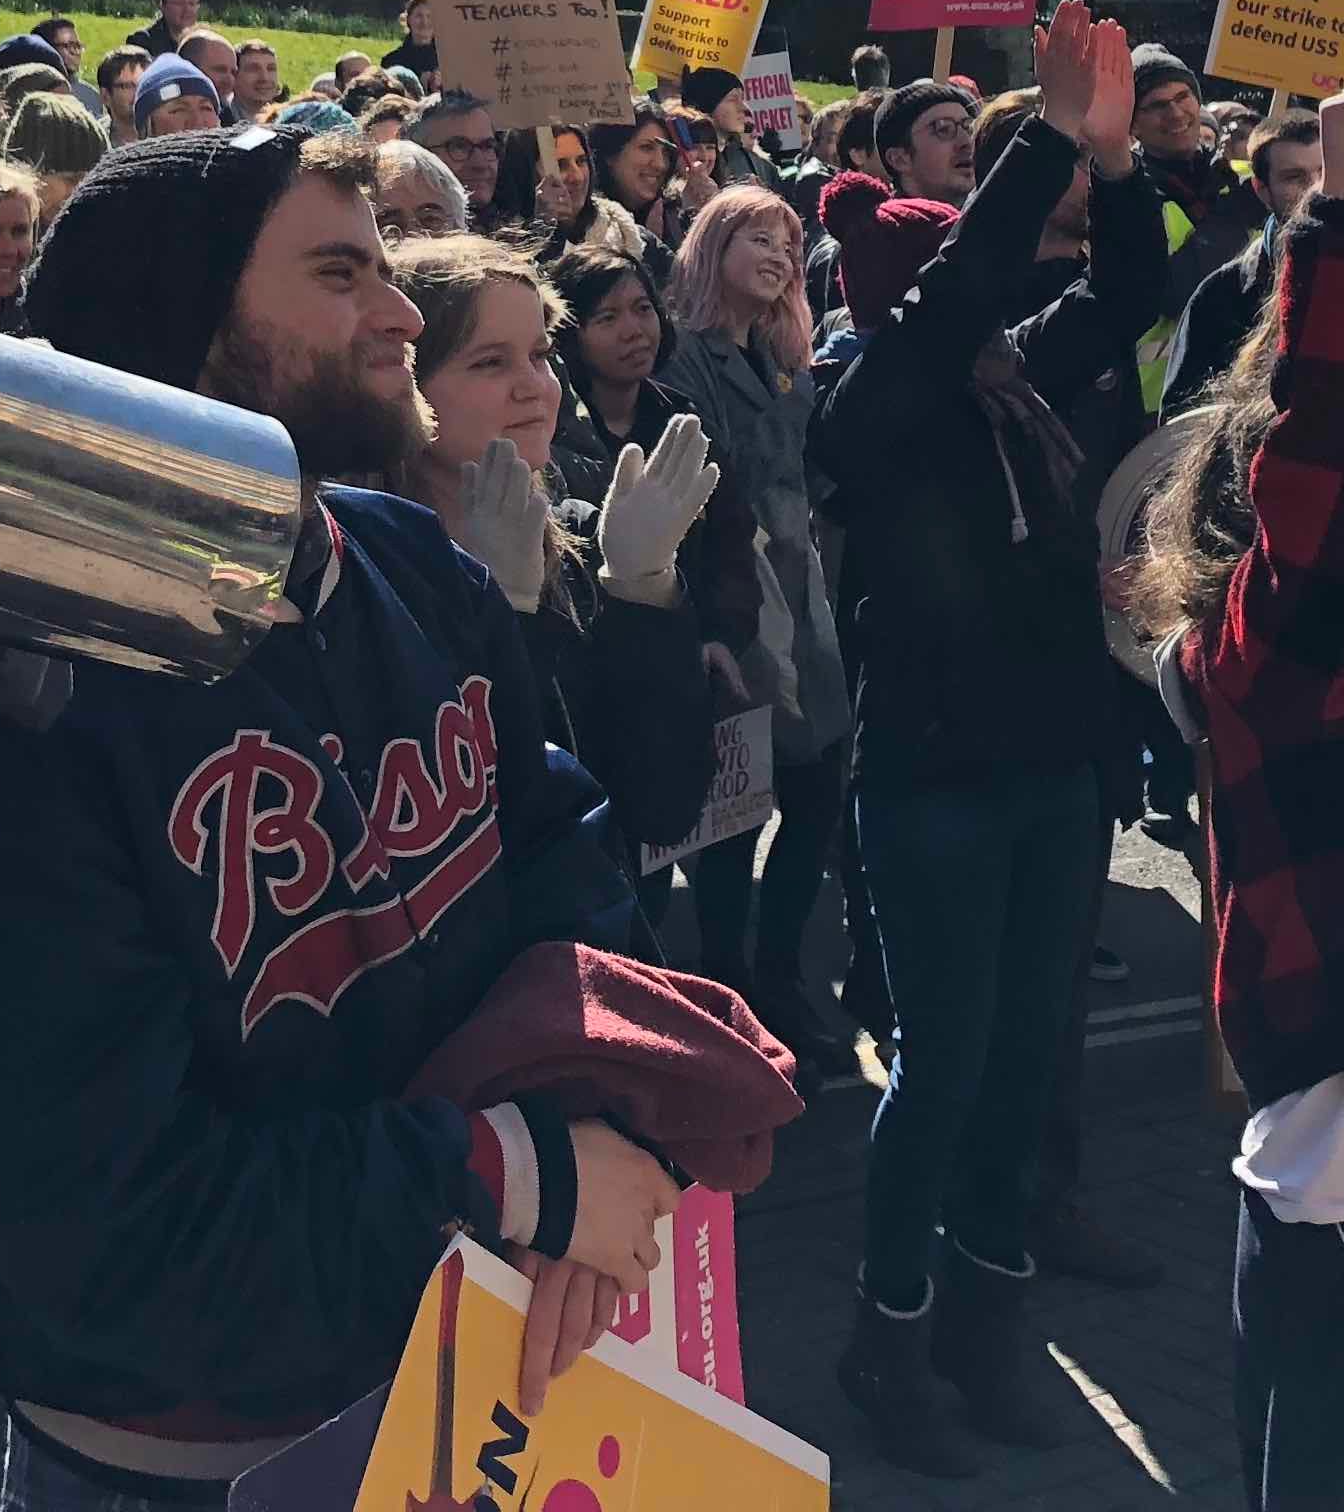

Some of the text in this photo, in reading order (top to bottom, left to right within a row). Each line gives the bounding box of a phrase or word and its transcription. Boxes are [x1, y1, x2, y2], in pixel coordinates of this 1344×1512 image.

[453, 3, 558, 21] TEACHERS
[656, 4, 711, 29] Support
[1272, 3, 1327, 30] strike
[648, 35, 721, 63] defend USS
[653, 21, 729, 49] our strike to
[1230, 20, 1340, 58] defend USS
[743, 72, 793, 101] FFICIAL
[745, 106, 794, 135] ICKET
